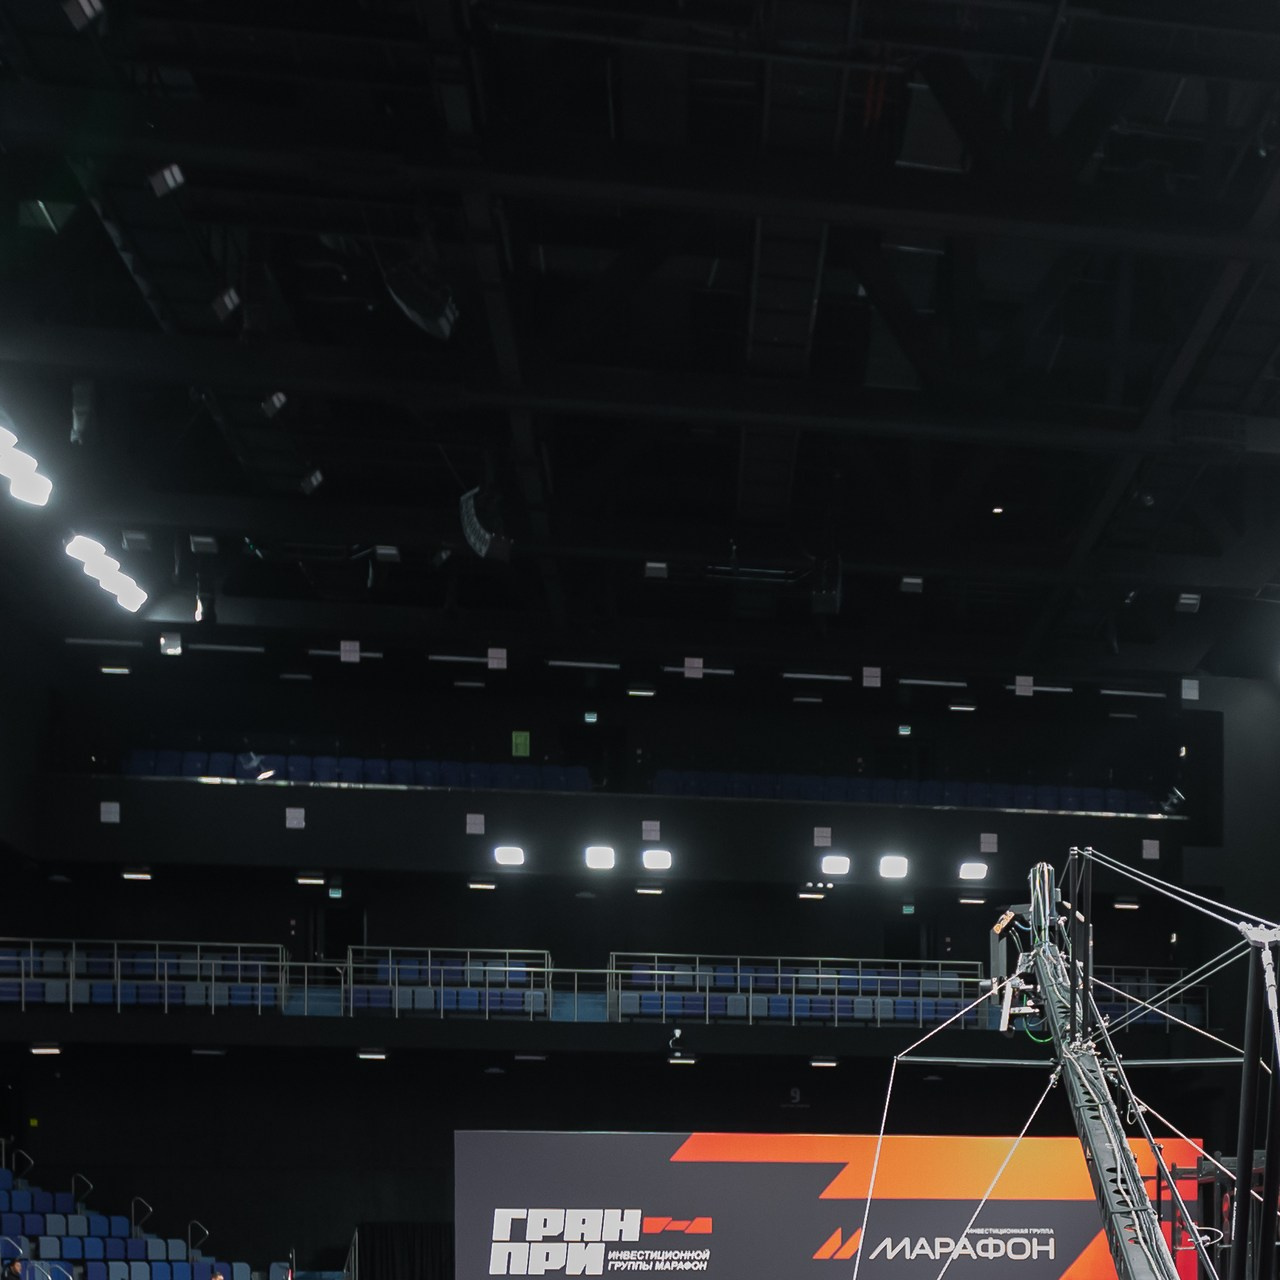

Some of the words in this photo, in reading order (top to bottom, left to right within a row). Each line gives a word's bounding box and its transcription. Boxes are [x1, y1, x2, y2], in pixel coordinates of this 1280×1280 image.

[492, 1208, 642, 1241] ГРАН
[489, 1242, 606, 1275] ПРИ
[608, 1249, 710, 1261] ИНВЕСТИЦИОННОЙ
[866, 1236, 1055, 1260] МАРАФОН
[608, 1260, 653, 1271] ГРУППЫ
[655, 1260, 708, 1271] МАРАФОН
